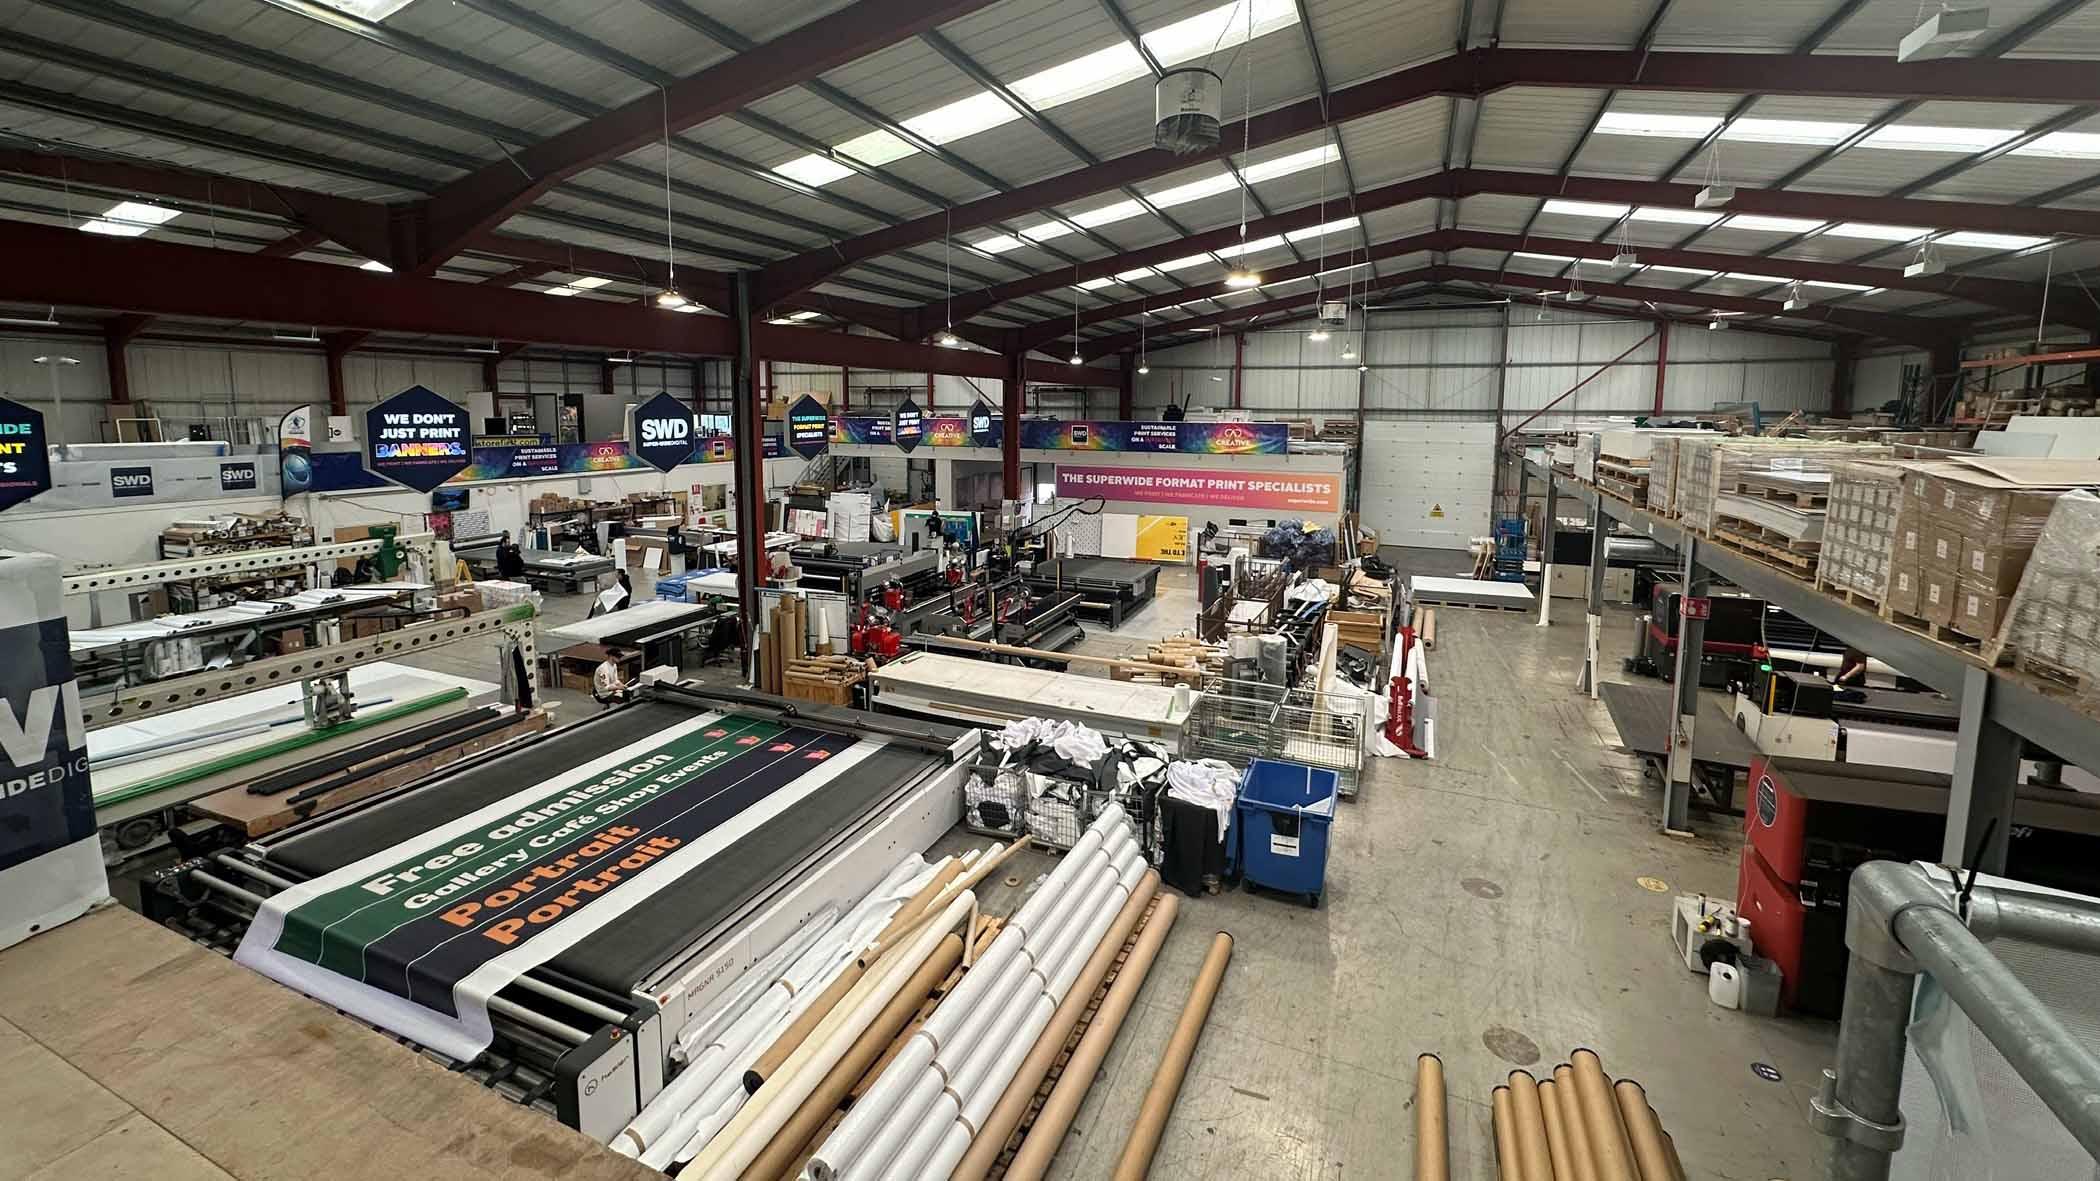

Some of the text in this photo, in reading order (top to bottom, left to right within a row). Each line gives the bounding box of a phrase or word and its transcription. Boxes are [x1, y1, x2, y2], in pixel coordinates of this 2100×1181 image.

[384, 414, 456, 425] WE DON'T
[642, 418, 689, 441] SWD
[973, 416, 990, 429] SWD
[380, 428, 461, 439] JUST PRINT
[113, 475, 151, 487] SWD
[222, 470, 254, 481] SWD
[1062, 473, 1332, 494] THE SUPERWIDE FORMAT PRINT SPECIALISTS
[361, 754, 675, 896] Free admission
[404, 750, 729, 909] Gallery Café Shop Events
[440, 825, 641, 928] Portrait
[482, 836, 682, 945] Portrait
